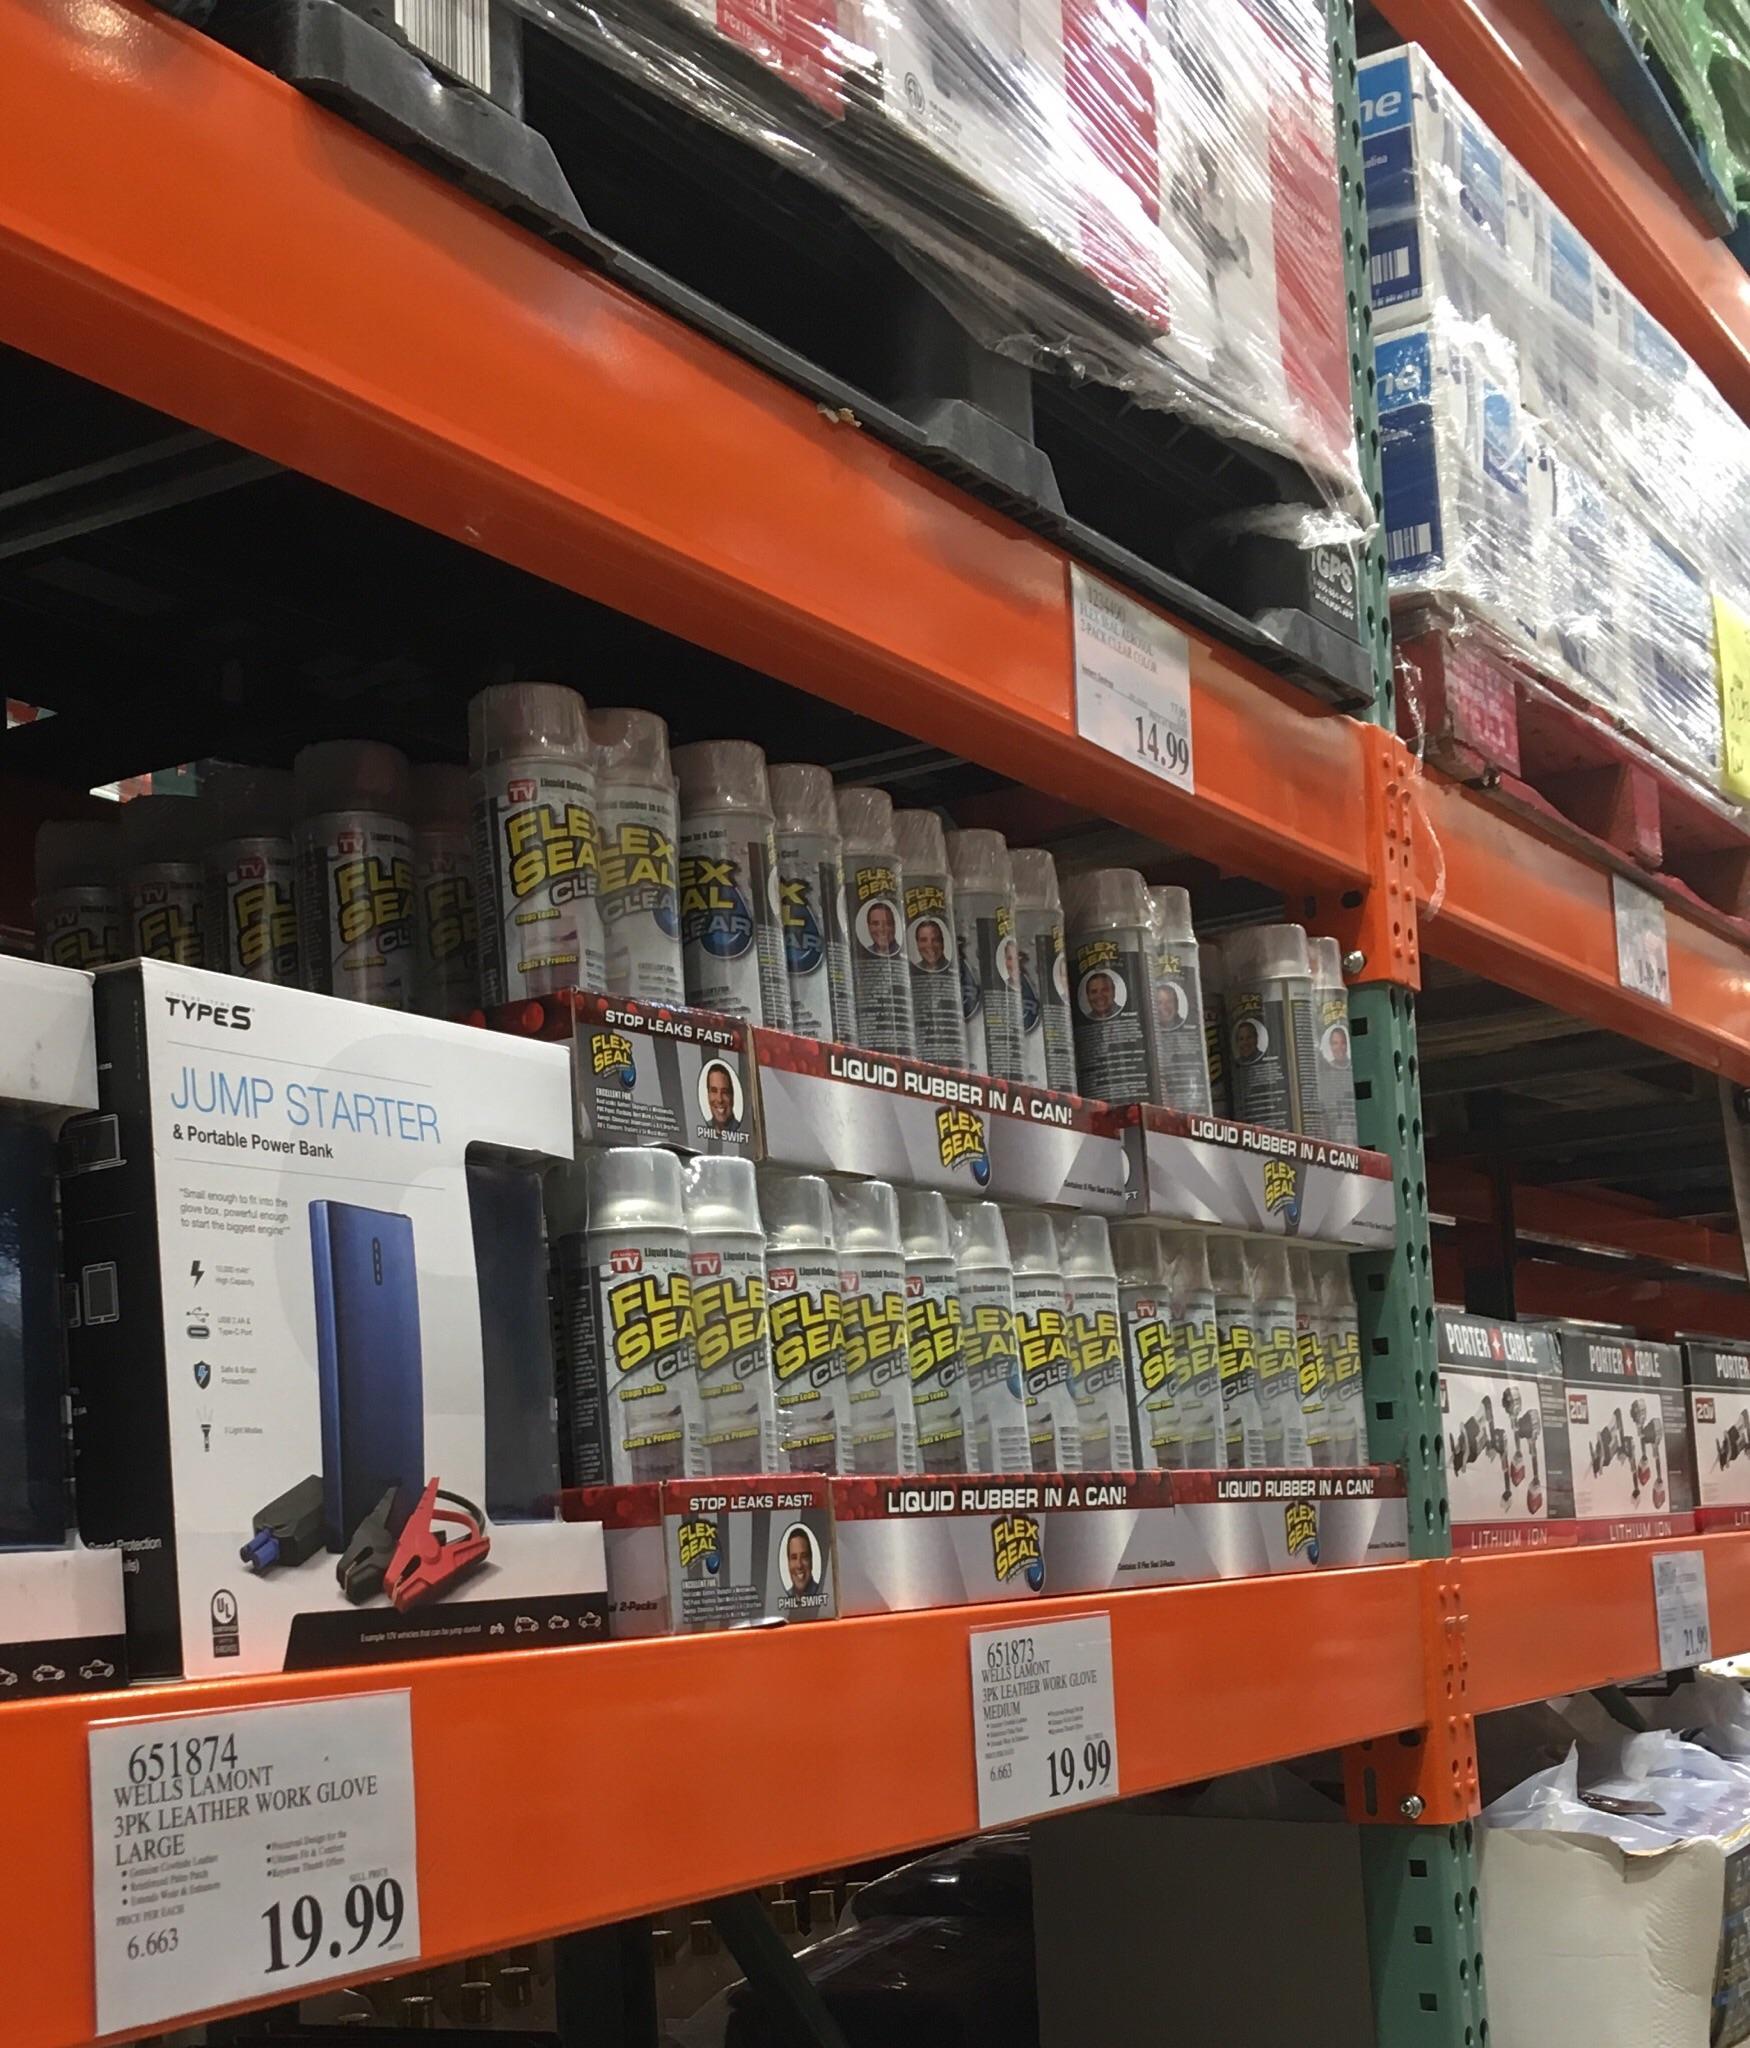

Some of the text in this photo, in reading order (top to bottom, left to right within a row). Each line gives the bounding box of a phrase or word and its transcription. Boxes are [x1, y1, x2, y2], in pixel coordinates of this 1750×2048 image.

[1135, 716, 1190, 776] 14.99
[509, 785, 534, 801] TV
[338, 835, 364, 854] TV
[508, 807, 597, 855] FLE
[239, 863, 263, 878] TV
[514, 840, 598, 896] SEA
[856, 869, 897, 887] FLEX
[552, 876, 598, 905] CLE
[859, 880, 897, 900] SEAL
[905, 887, 945, 904] FLEX
[907, 899, 945, 918] SEAL
[605, 1009, 734, 1046] STOP LEAKS FAST!
[591, 1033, 633, 1056] FLEX
[593, 1049, 632, 1073] SEAL
[170, 1065, 442, 1145] JUMP STARTER
[830, 1055, 1073, 1126] LIQUID RUBBER IN A CAN!
[698, 1127, 750, 1143] PHIL SWIFT
[938, 1110, 984, 1139] FLEX
[172, 1123, 334, 1160] & Portable Power Bank
[941, 1133, 985, 1167] SEAL
[1190, 1119, 1359, 1170] LIQUID RUBBER IN A CAN!
[1264, 1160, 1296, 1184] FLEX
[208, 1191, 238, 1206] enough
[1265, 1180, 1296, 1212] SEAL
[180, 1203, 203, 1215] glove
[223, 1208, 258, 1219] powerful
[260, 1211, 289, 1224] enough
[191, 1219, 211, 1230] start
[211, 1220, 225, 1231] the
[226, 1222, 256, 1235] biggest
[614, 1257, 640, 1271] TV
[694, 1260, 718, 1275] TV
[611, 1275, 692, 1329] FLE
[694, 1279, 766, 1329] FLE
[1137, 1305, 1154, 1317] TV
[770, 1293, 842, 1341] FLE
[617, 1310, 696, 1371] SEA
[699, 1312, 767, 1371] SEA
[776, 1323, 845, 1380] SEA
[910, 1325, 963, 1380] SEA
[1445, 1322, 1538, 1364] PORTER CABLE
[1589, 1345, 1624, 1375] PORTER
[1715, 1354, 1750, 1380] PORTER
[690, 1493, 813, 1511] STOP LEAKS FAST!
[888, 1486, 1127, 1513] LIQUID RUBBER IN A CAN!
[1218, 1479, 1374, 1498] LIQUID RUBBER IN A CAN!
[1286, 1505, 1317, 1531] FLEX
[1609, 1521, 1672, 1541] LITHIUM ION
[117, 1536, 162, 1551] Protection
[679, 1521, 718, 1546] FLEX
[993, 1518, 1039, 1552] FLEX
[1288, 1522, 1316, 1555] SEAL
[1471, 1527, 1548, 1549] LITHIUM ION
[680, 1538, 717, 1567] SEAL
[996, 1540, 1039, 1582] SEAL
[620, 1600, 658, 1611] 2-Packs
[778, 1594, 829, 1610] PHIL SWIFT
[360, 1632, 386, 1643] Example
[987, 1638, 1035, 1669] 651873
[981, 1660, 1051, 1684] WELLS LAMONT
[982, 1669, 1097, 1703] 3PK LEATHER WORK GLOVE
[983, 1701, 1021, 1721] MEDIUM
[128, 1733, 238, 1784] 651874
[990, 1763, 1012, 1782] 6.663
[1046, 1739, 1112, 1798] 19.99
[114, 1765, 274, 1809] WELLS LAMONT
[114, 1774, 378, 1839] 3PK LEATHER WORK GLOVE
[115, 1834, 186, 1867] LARGE
[261, 1877, 405, 1974] 19.99
[127, 1927, 179, 1960] 6.663
